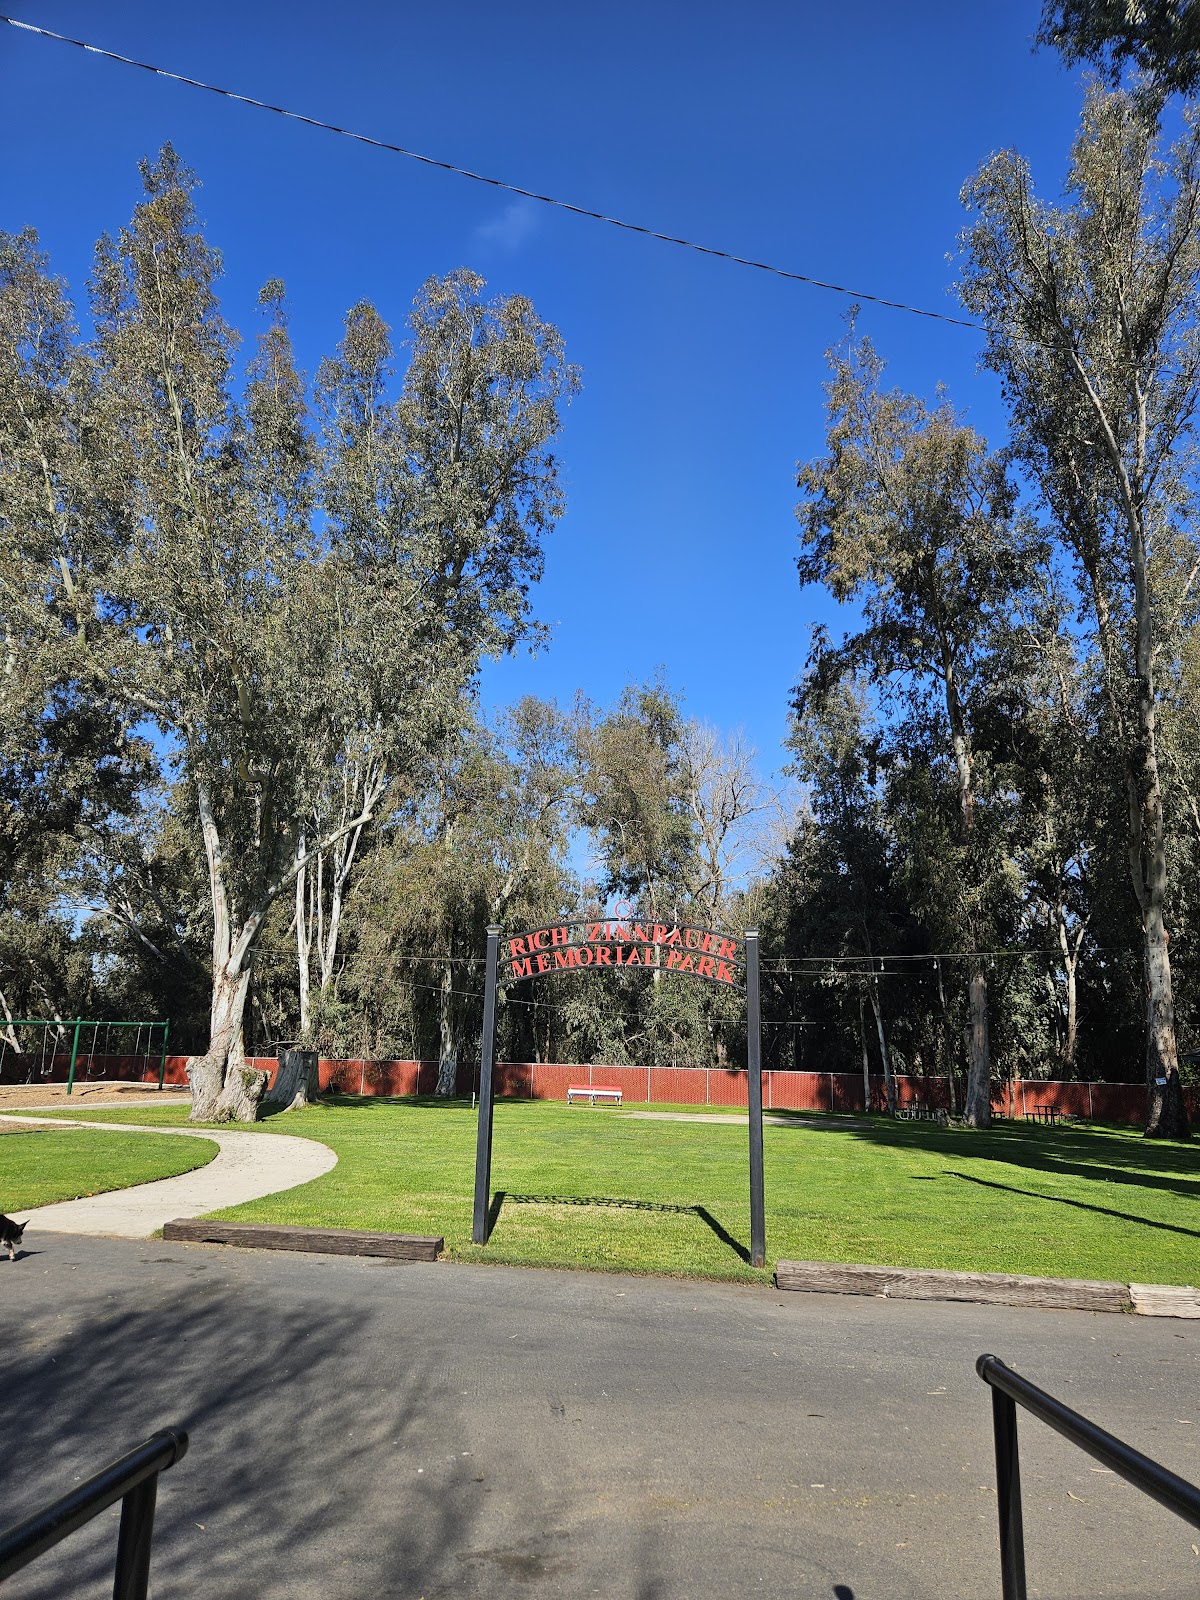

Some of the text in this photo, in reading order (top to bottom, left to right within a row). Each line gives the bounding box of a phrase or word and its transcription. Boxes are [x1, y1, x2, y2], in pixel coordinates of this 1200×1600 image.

[508, 923, 737, 960] RICH ZINNBAUER
[511, 946, 737, 983] MEMORIAL PARK
